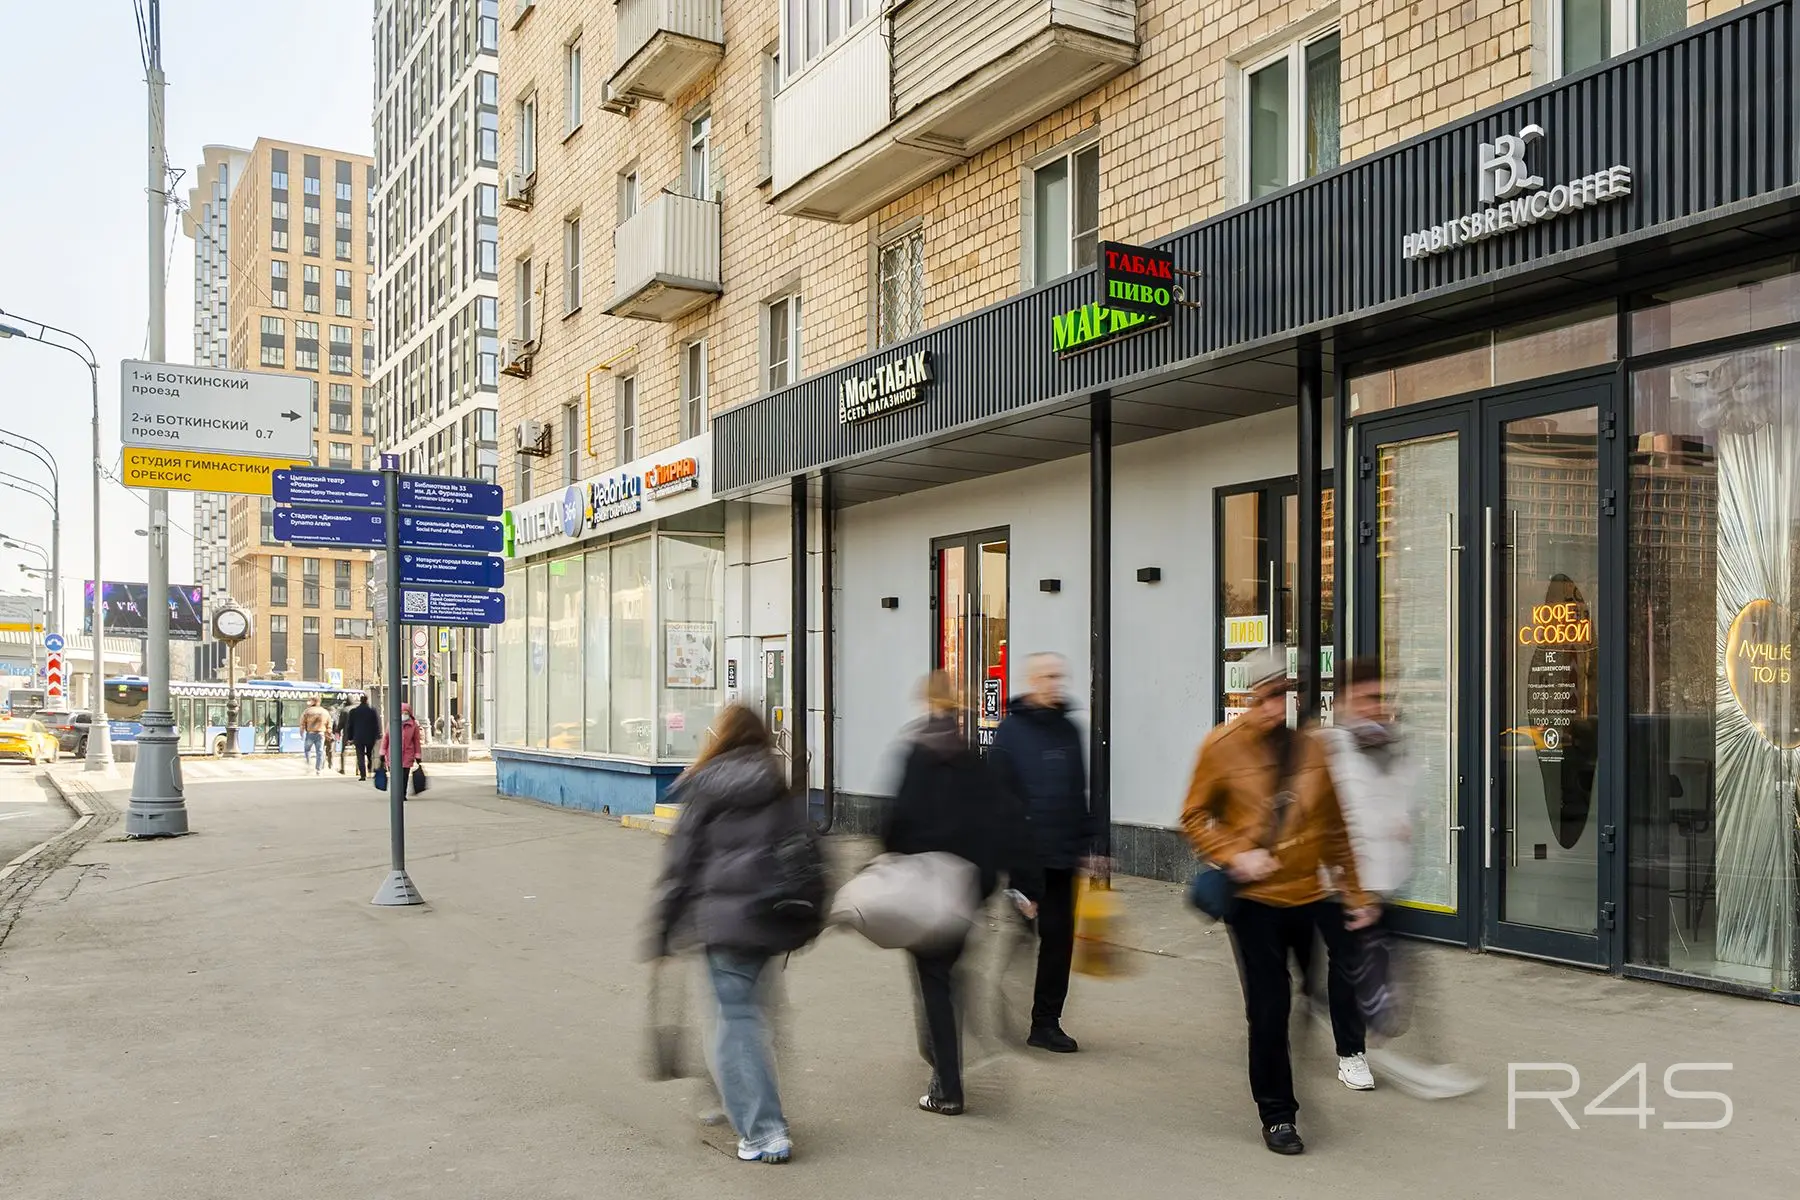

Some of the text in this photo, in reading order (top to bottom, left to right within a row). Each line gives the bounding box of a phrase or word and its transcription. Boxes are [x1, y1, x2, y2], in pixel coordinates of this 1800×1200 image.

[1403, 164, 1631, 260] HABITSBREWCOFFEE
[1106, 250, 1172, 279] ТАБАК
[1109, 280, 1170, 306] ПИВО
[132, 371, 249, 390] 1-й БОТКИНСКИЙ
[845, 350, 927, 408] МосТАБАК
[132, 386, 180, 397] проезд
[847, 405, 866, 421] СЕТЬ
[867, 387, 916, 415] МАГАЗИНОВ
[132, 413, 249, 431] 2-й БОТКИНСКИЙ
[132, 428, 180, 439] проезд
[255, 429, 274, 439] 0.7
[131, 455, 270, 474] СТУДИЯ ГИМНАСТИКИ
[131, 470, 192, 482] ОРЕКСИС
[327, 476, 345, 484] театр
[514, 501, 562, 545] АПТЕКА
[1532, 602, 1577, 625] КОФЕ
[1230, 620, 1264, 643] ПИВО
[1519, 620, 1590, 645] С СОБОЙ
[1532, 691, 1549, 700] 07:30
[1553, 692, 1570, 700] 20:00
[1553, 717, 1571, 726] 20:00
